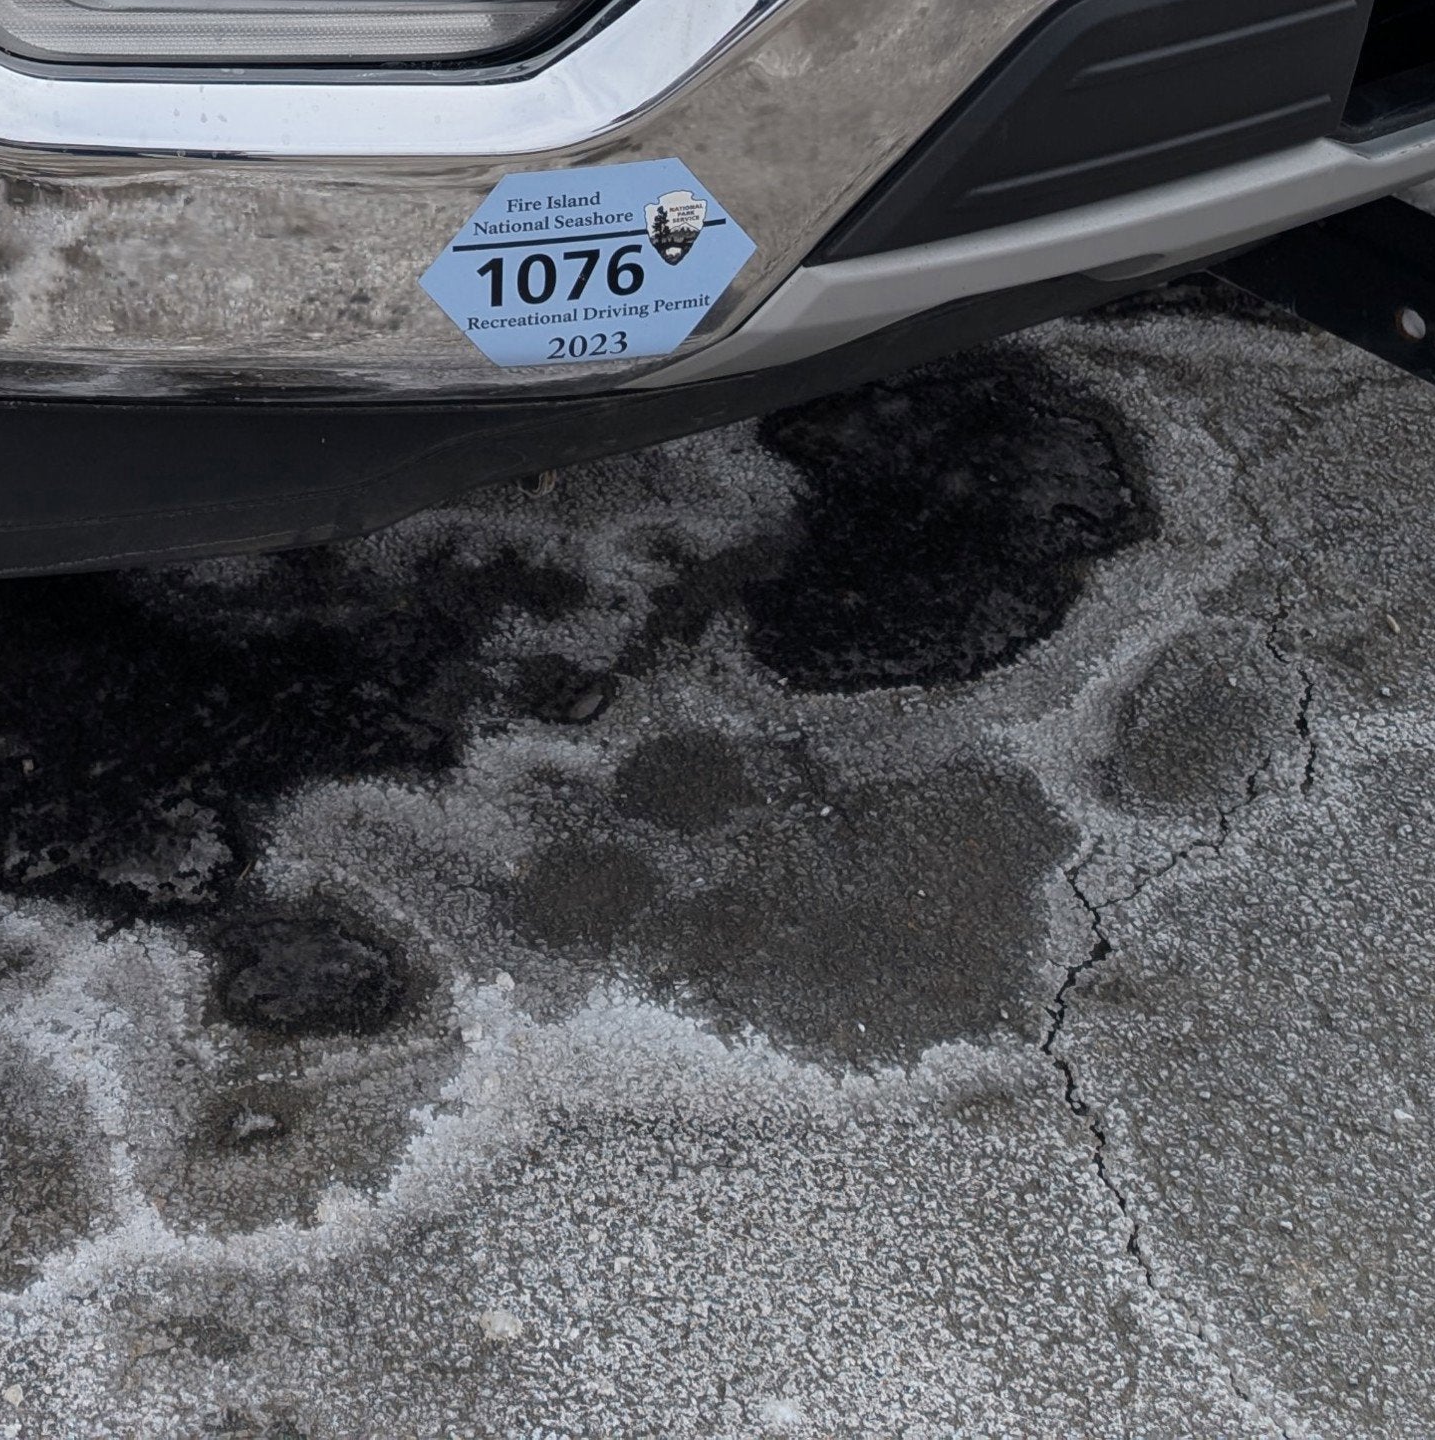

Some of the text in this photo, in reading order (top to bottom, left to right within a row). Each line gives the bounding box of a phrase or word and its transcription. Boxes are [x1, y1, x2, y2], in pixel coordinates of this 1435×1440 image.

[507, 192, 601, 213] Fire Island
[669, 203, 703, 212] NATIONAL
[473, 210, 634, 236] National Seashore
[476, 244, 645, 307] 1076
[467, 294, 711, 331] Recreational Driving Permit
[546, 331, 628, 360] 2023
